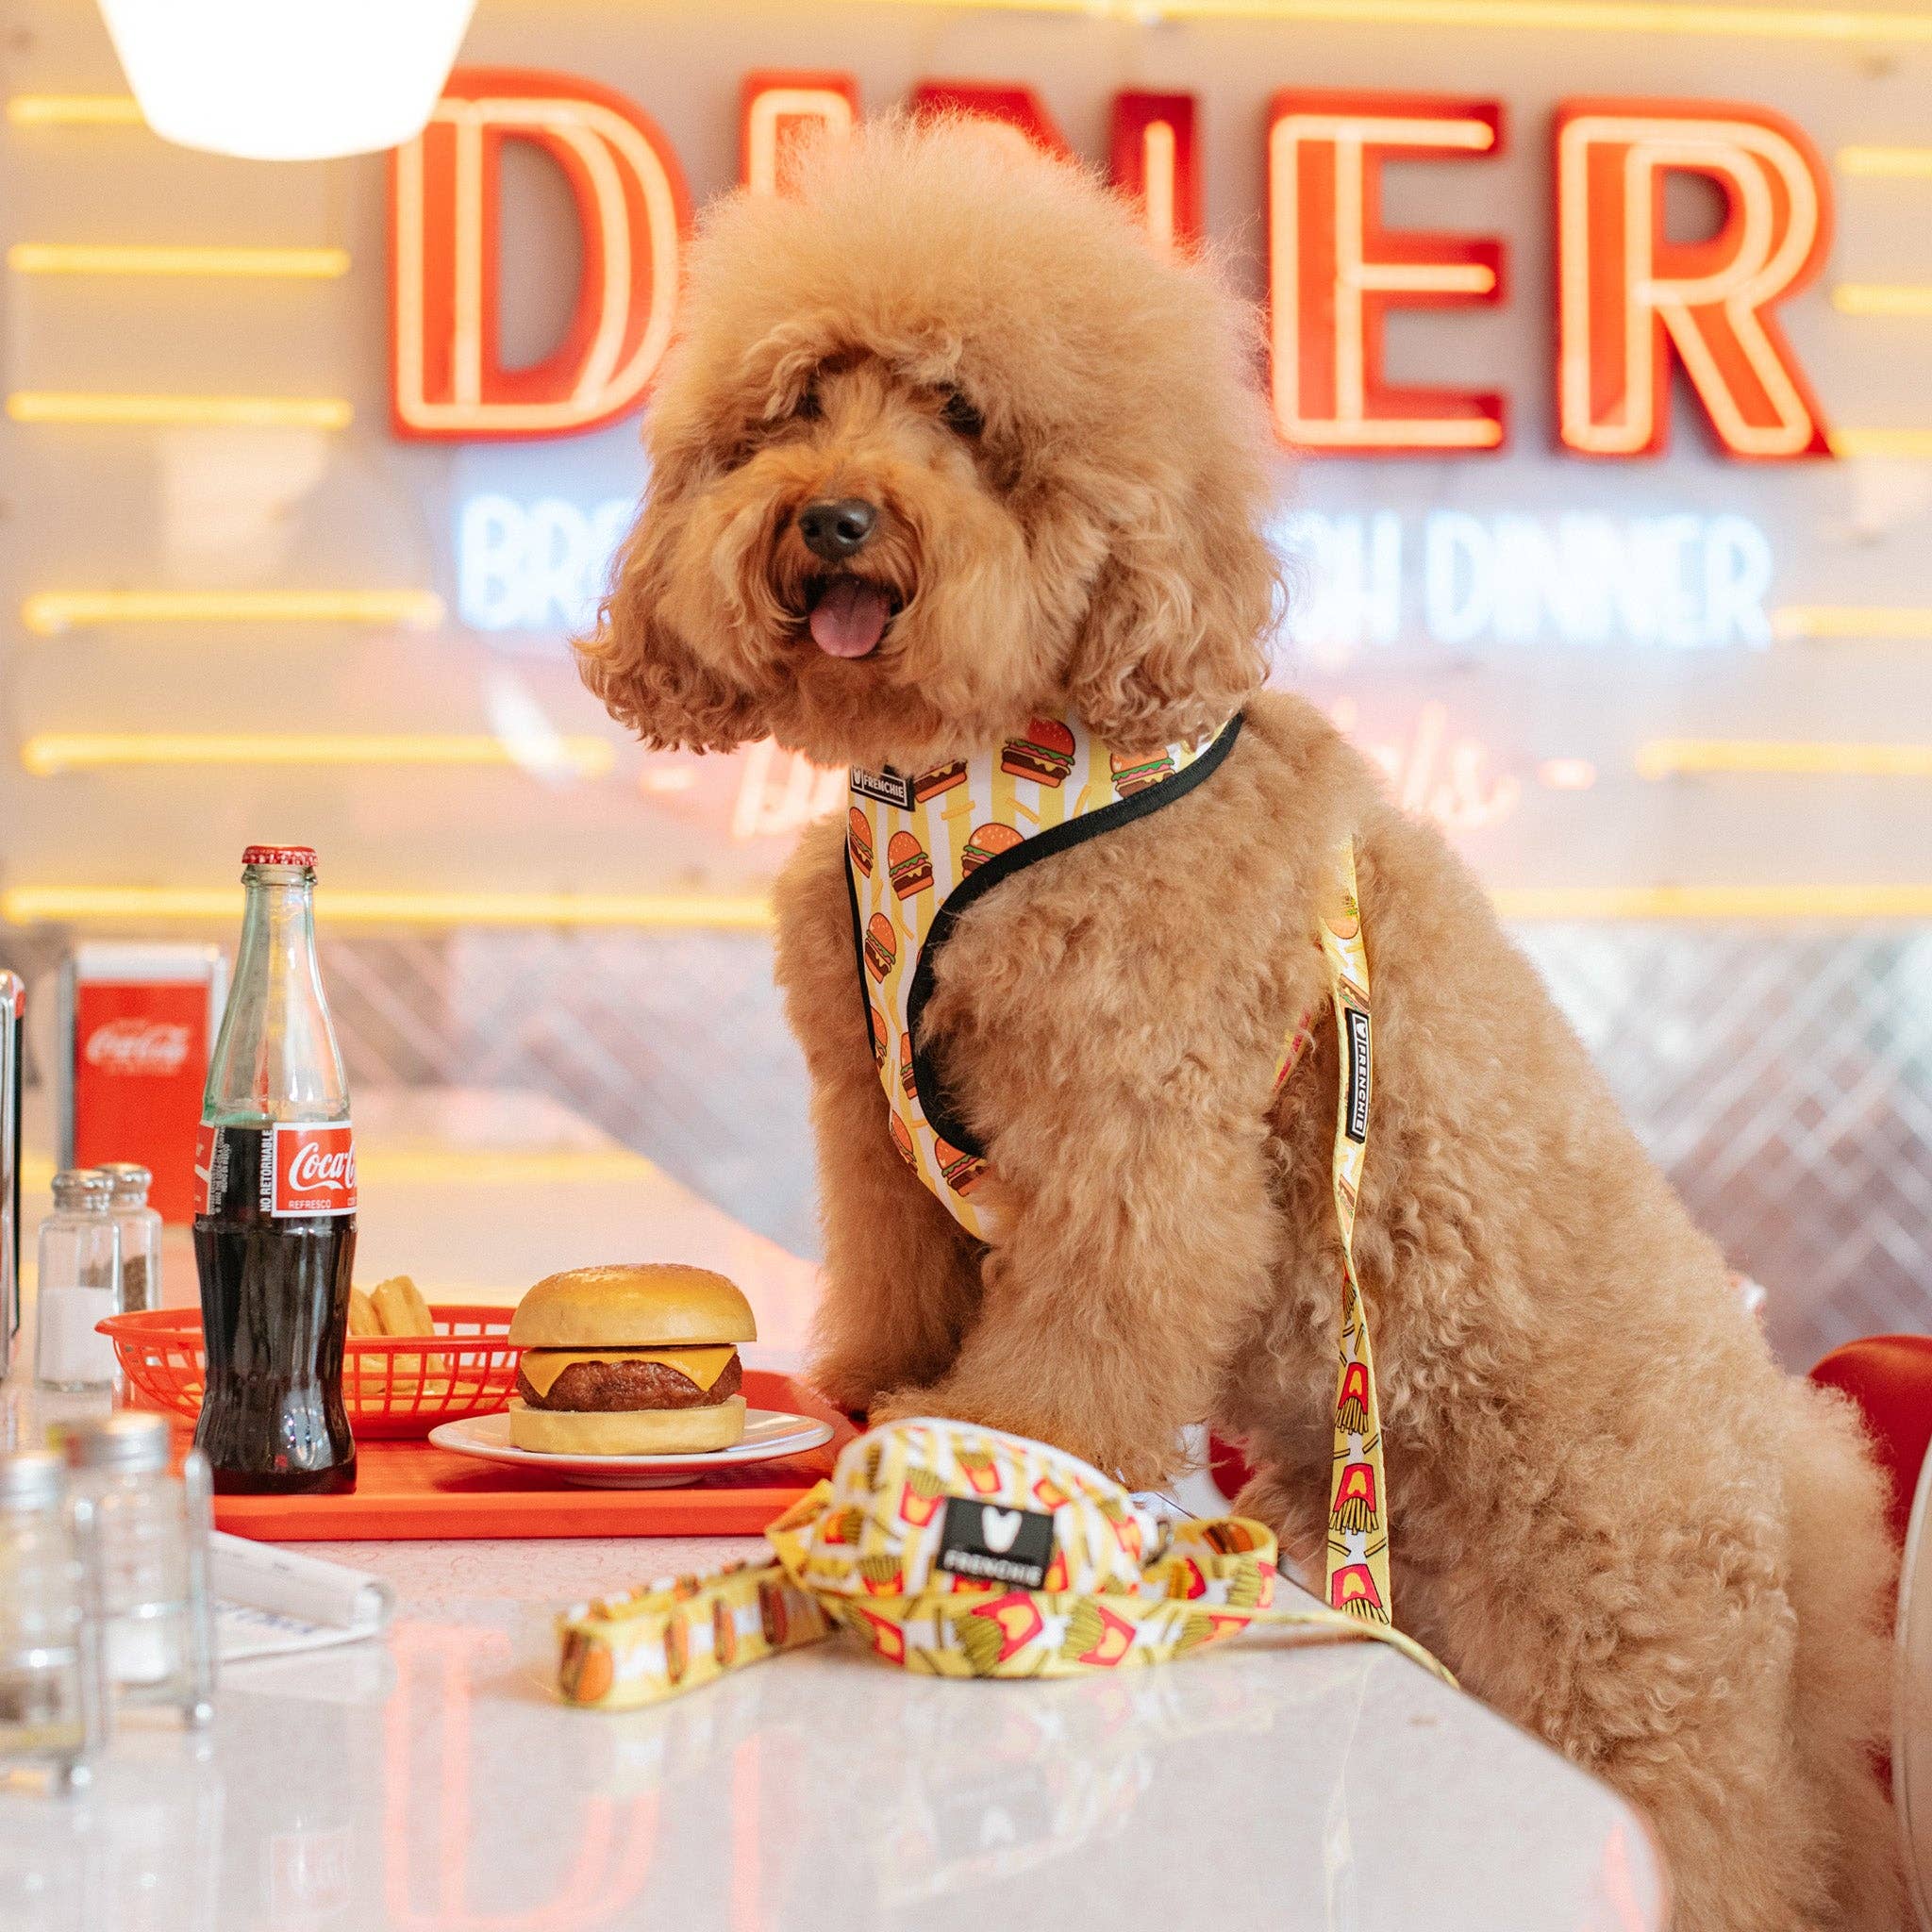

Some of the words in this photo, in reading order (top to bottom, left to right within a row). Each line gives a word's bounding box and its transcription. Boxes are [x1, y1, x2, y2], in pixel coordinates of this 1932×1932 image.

[389, 68, 1841, 463] DER
[1425, 508, 1774, 651] DINNER
[863, 774, 904, 798] FRENCHIE
[1356, 1044, 1367, 1131] FRENCHIE
[260, 1129, 273, 1196] RETORNABLE
[259, 1196, 272, 1212] NO
[289, 1199, 332, 1210] REFRESCO
[944, 1548, 1043, 1587] FRENCHIE
